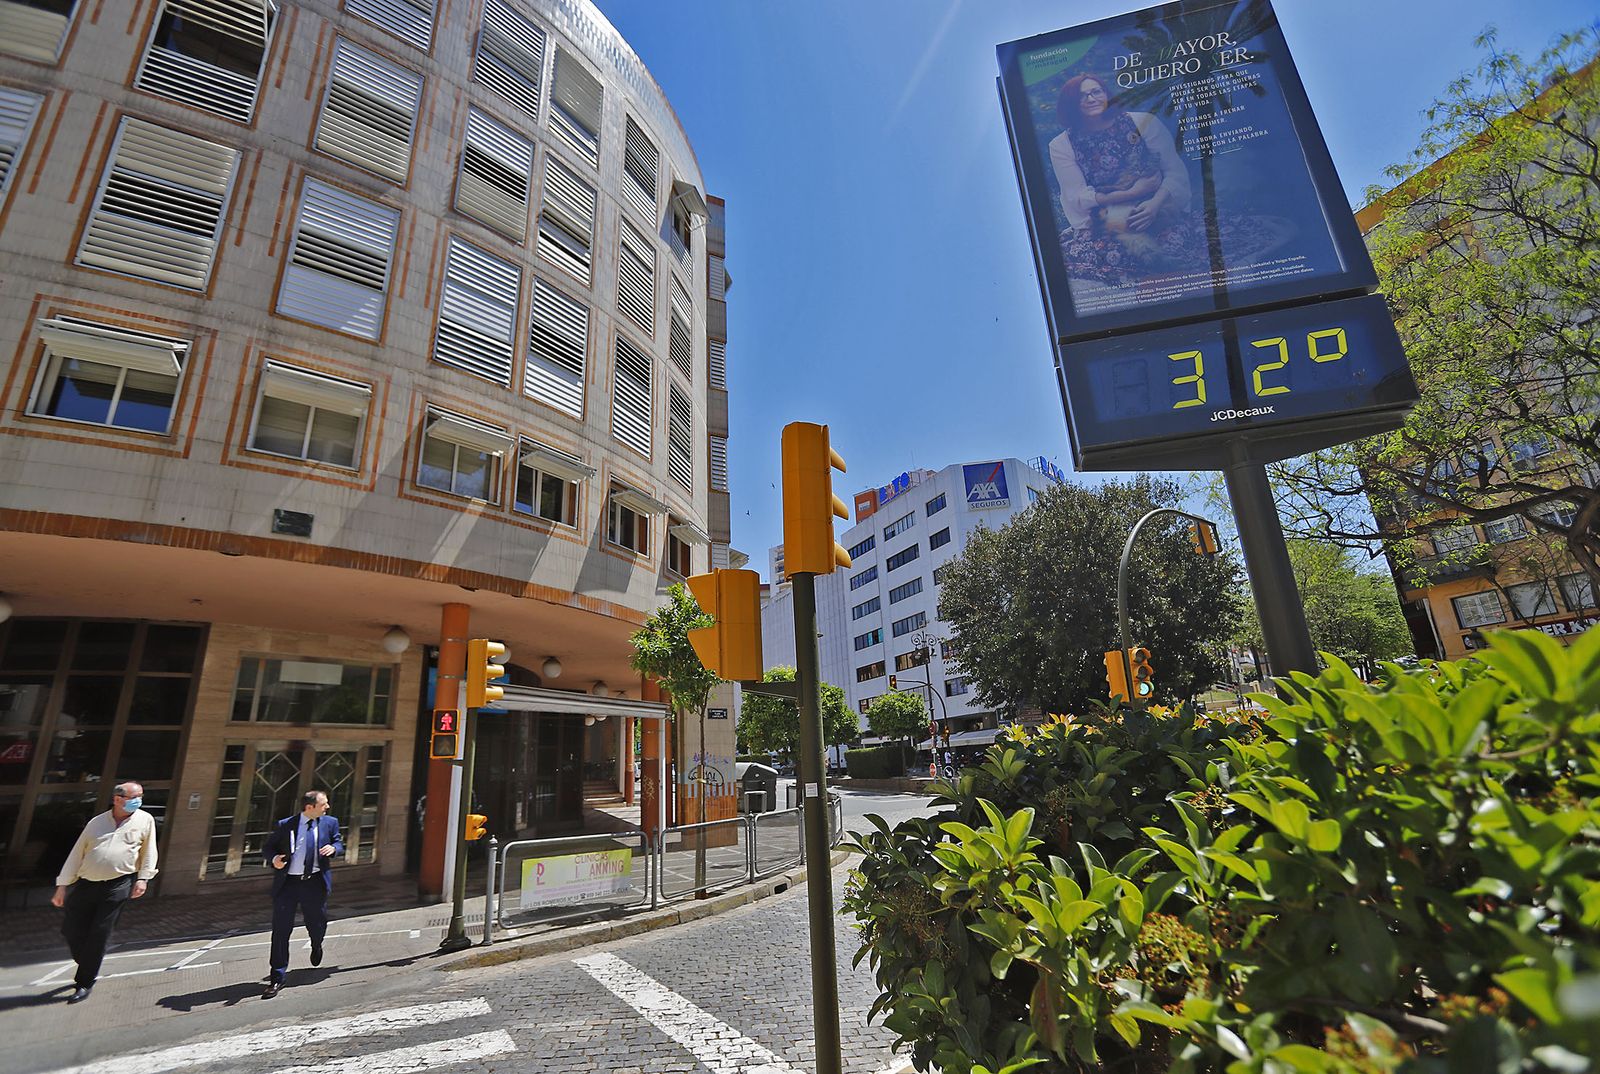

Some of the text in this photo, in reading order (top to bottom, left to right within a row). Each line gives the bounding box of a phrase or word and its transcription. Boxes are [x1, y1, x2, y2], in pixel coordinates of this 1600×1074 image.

[1030, 47, 1068, 60] fundación
[1113, 32, 1237, 71] DE AYOR,
[1117, 57, 1201, 89] QUIERO
[1169, 77, 1215, 91] INVESTIGAMOS
[1236, 69, 1249, 77] QUE
[1171, 73, 1261, 98] PUEDAS SER QUIEN QUIERAS
[1196, 91, 1217, 100] TODAS
[1233, 81, 1257, 91] ETAPAS
[1220, 105, 1246, 116] FRENAR
[1183, 125, 1253, 146] COLABORA ENVIANDO
[1196, 142, 1210, 151] SMS
[1212, 139, 1226, 147] CON
[1238, 129, 1269, 141] PALABRA
[1210, 405, 1275, 422] JCDecaux
[967, 481, 1001, 500] AXA
[971, 500, 1006, 509] SEGUROS
[575, 860, 624, 878] ANNING
